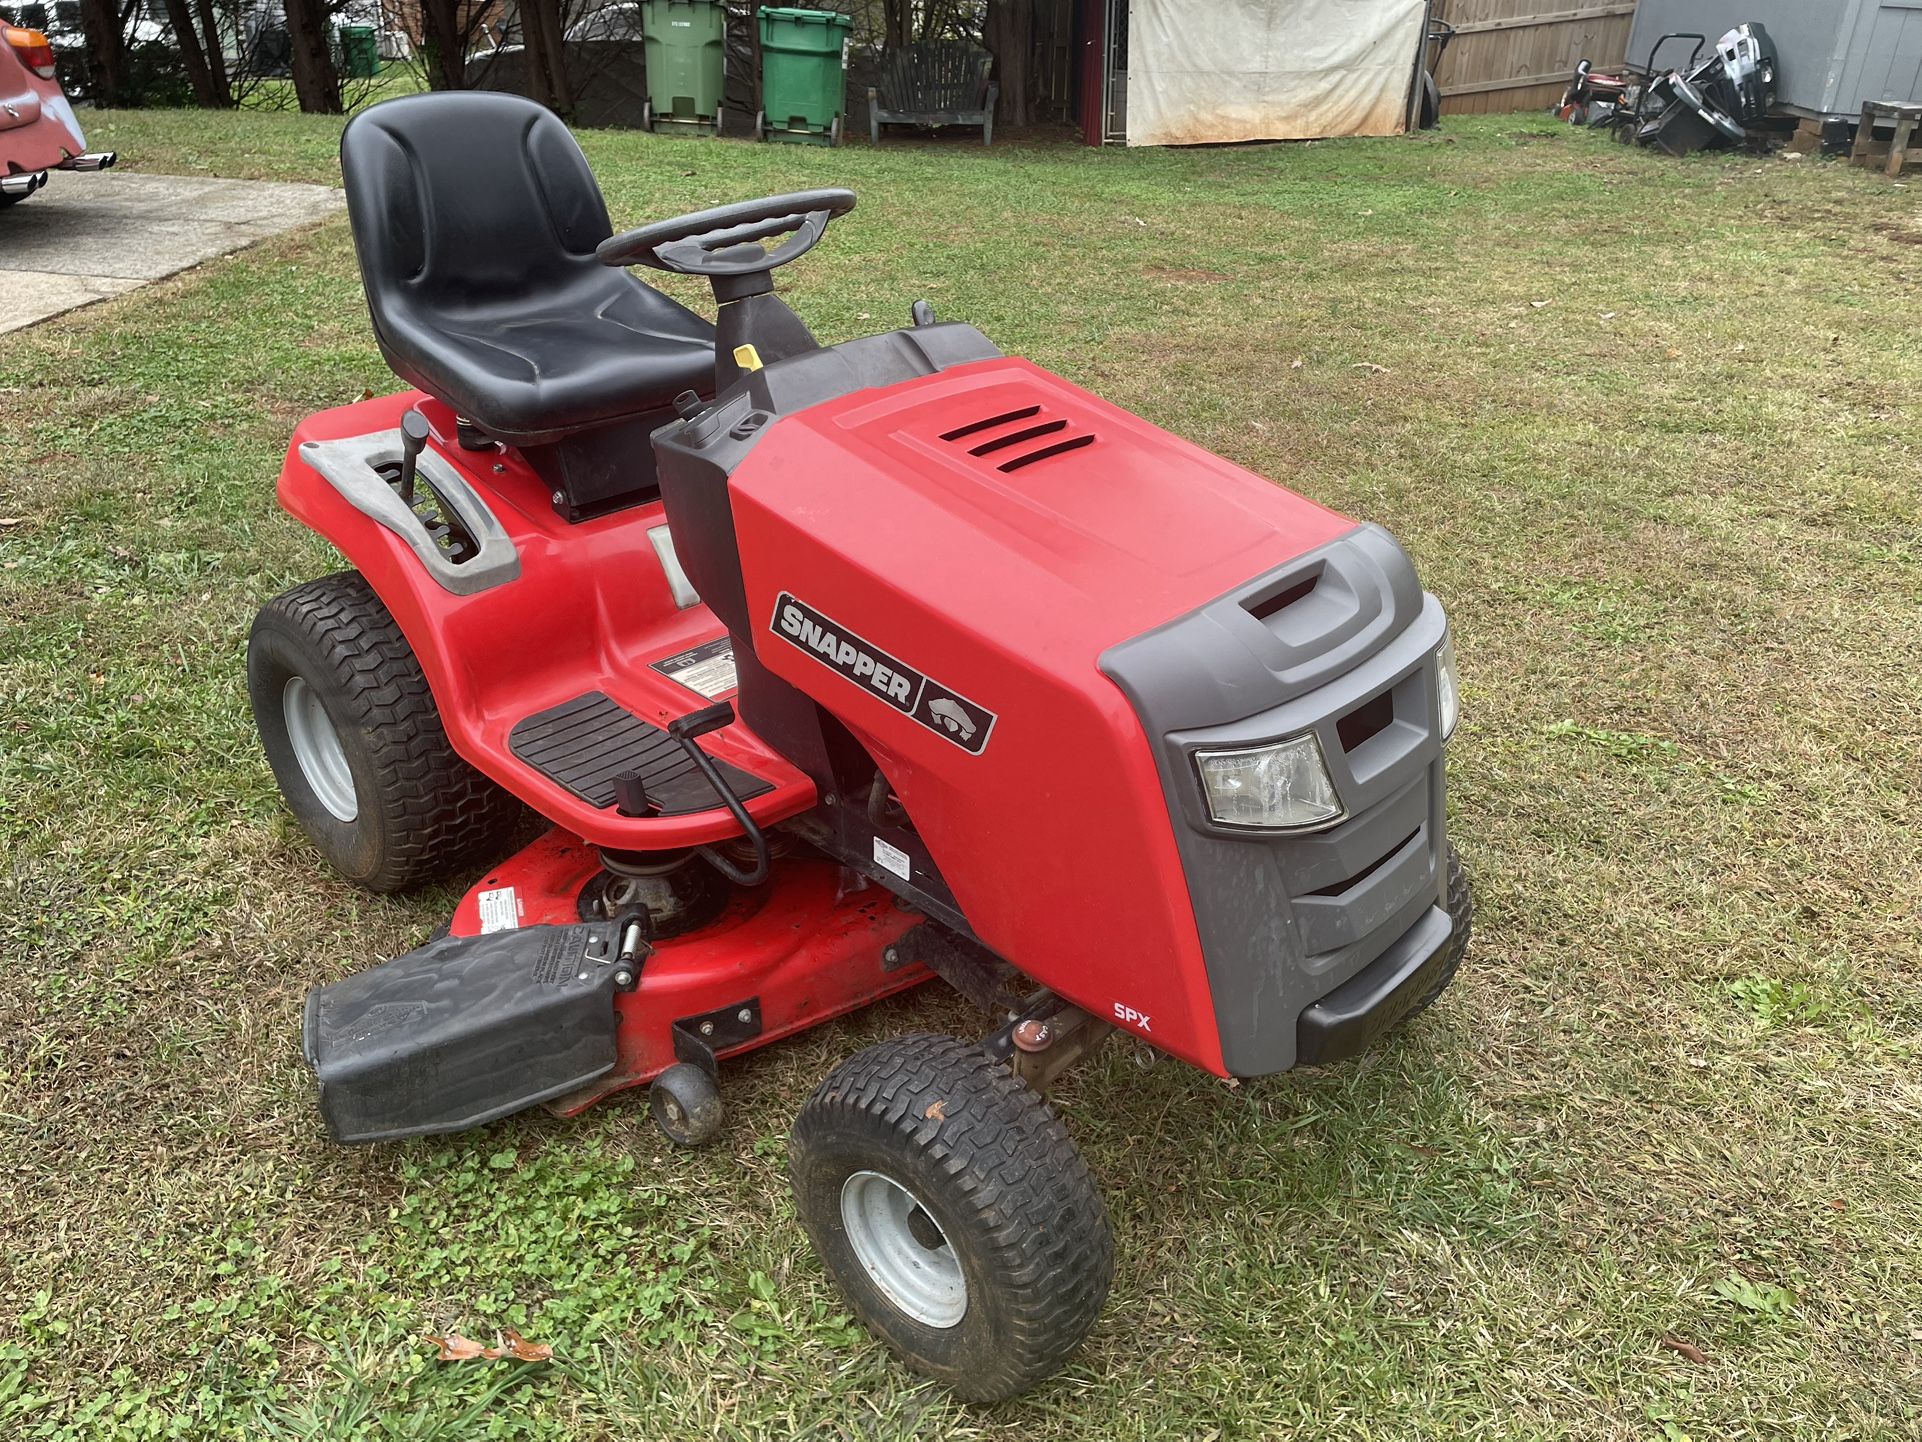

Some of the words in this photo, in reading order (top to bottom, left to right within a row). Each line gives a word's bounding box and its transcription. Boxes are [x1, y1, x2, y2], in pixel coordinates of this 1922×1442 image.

[780, 604, 911, 705] SNAPPER
[556, 926, 584, 987] CAUTION
[1036, 1025, 1049, 1041] CAST
[1114, 1002, 1151, 1032] SPX
